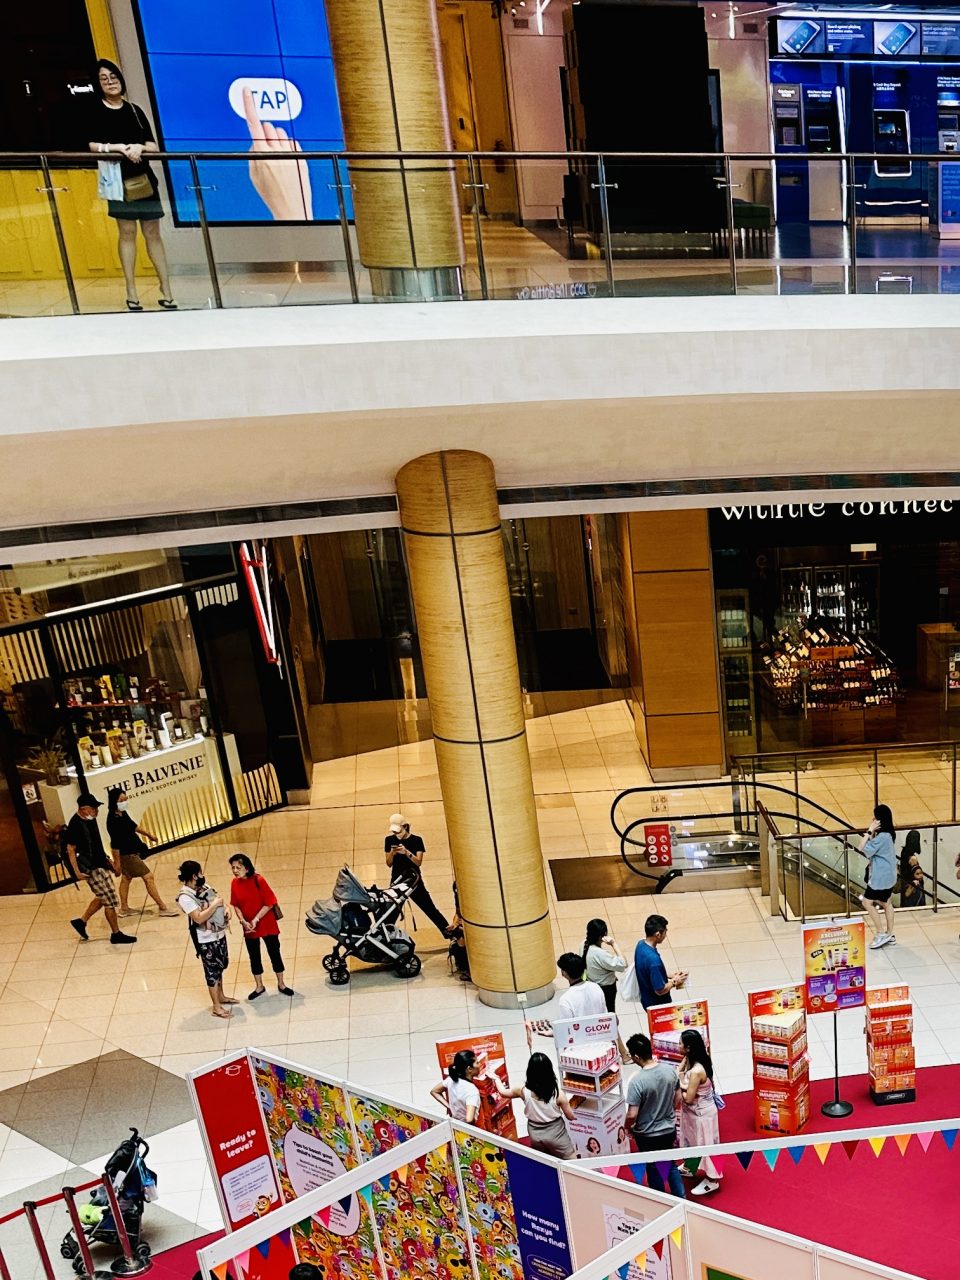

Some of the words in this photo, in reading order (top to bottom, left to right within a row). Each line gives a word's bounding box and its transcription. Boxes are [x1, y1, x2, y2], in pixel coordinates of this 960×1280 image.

[103, 779, 132, 793] THE
[132, 755, 204, 789] BALVENIE
[140, 787, 155, 796] MALT
[156, 780, 177, 790] SCOTCH
[178, 773, 198, 783] WHISKY
[585, 1024, 610, 1032] GLOW
[219, 1134, 246, 1151] Ready
[246, 1129, 256, 1137] to
[227, 1140, 253, 1158] leave?
[522, 1210, 537, 1221] How
[539, 1218, 559, 1231] many
[521, 1228, 534, 1237] can
[534, 1233, 548, 1242] you
[548, 1238, 566, 1249] find?
